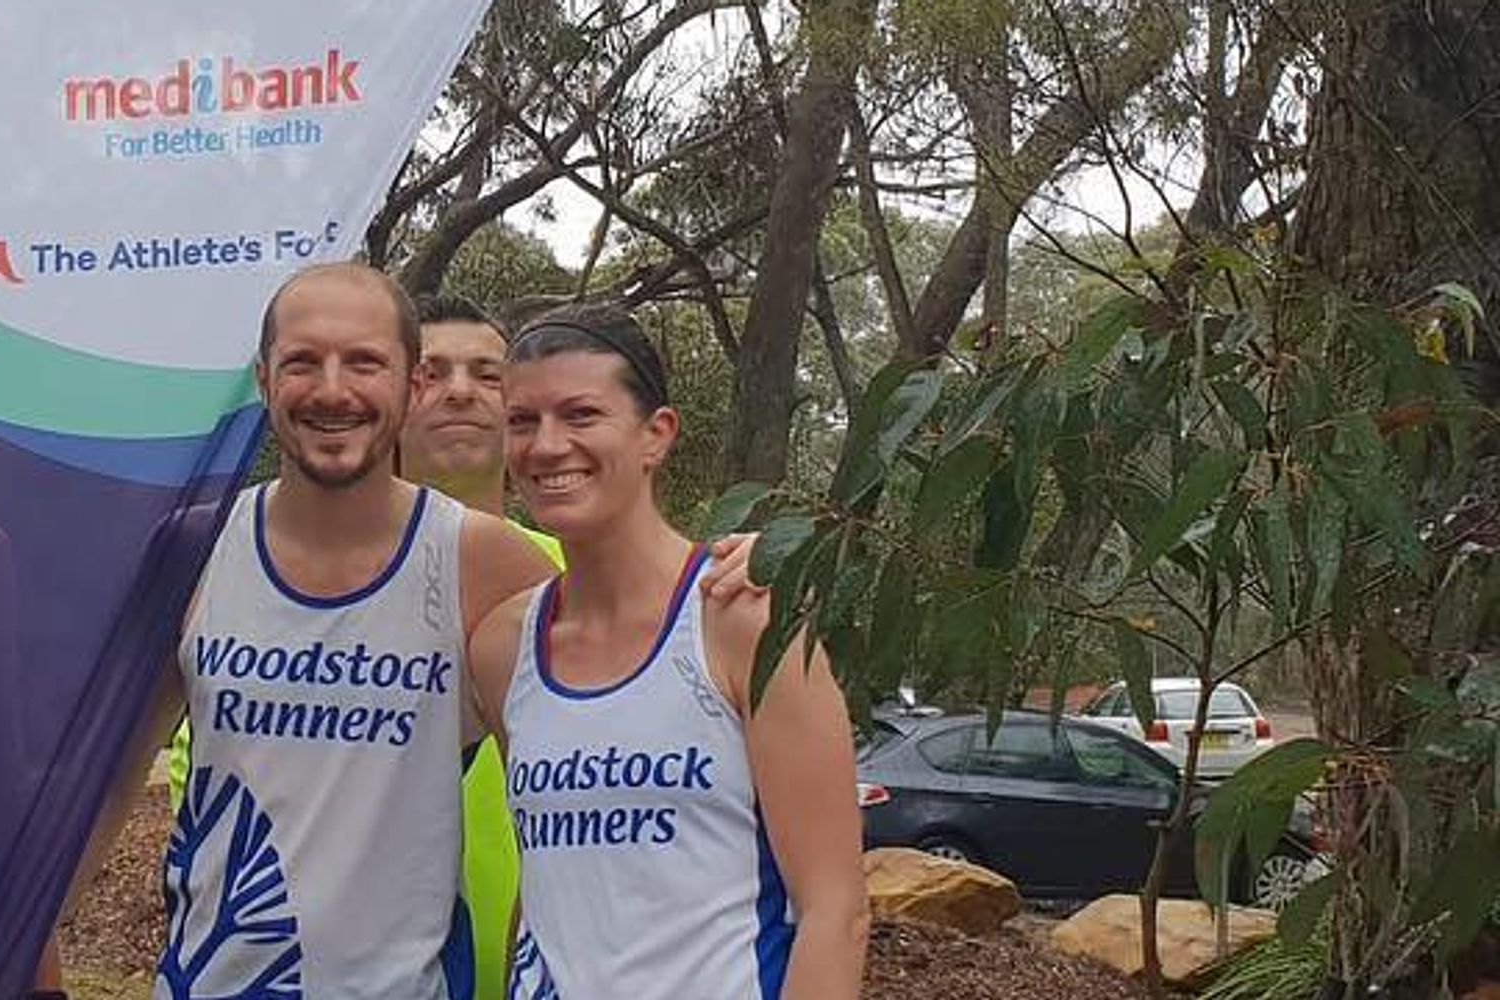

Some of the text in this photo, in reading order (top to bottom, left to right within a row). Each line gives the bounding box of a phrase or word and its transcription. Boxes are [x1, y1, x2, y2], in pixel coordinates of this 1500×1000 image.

[63, 50, 361, 121] medibank
[105, 119, 320, 156] For Better Health
[31, 243, 97, 272] The
[107, 236, 263, 270] Athlete's
[196, 635, 452, 694] Woodstock
[213, 689, 417, 746] Runners
[510, 746, 714, 797] oodstock
